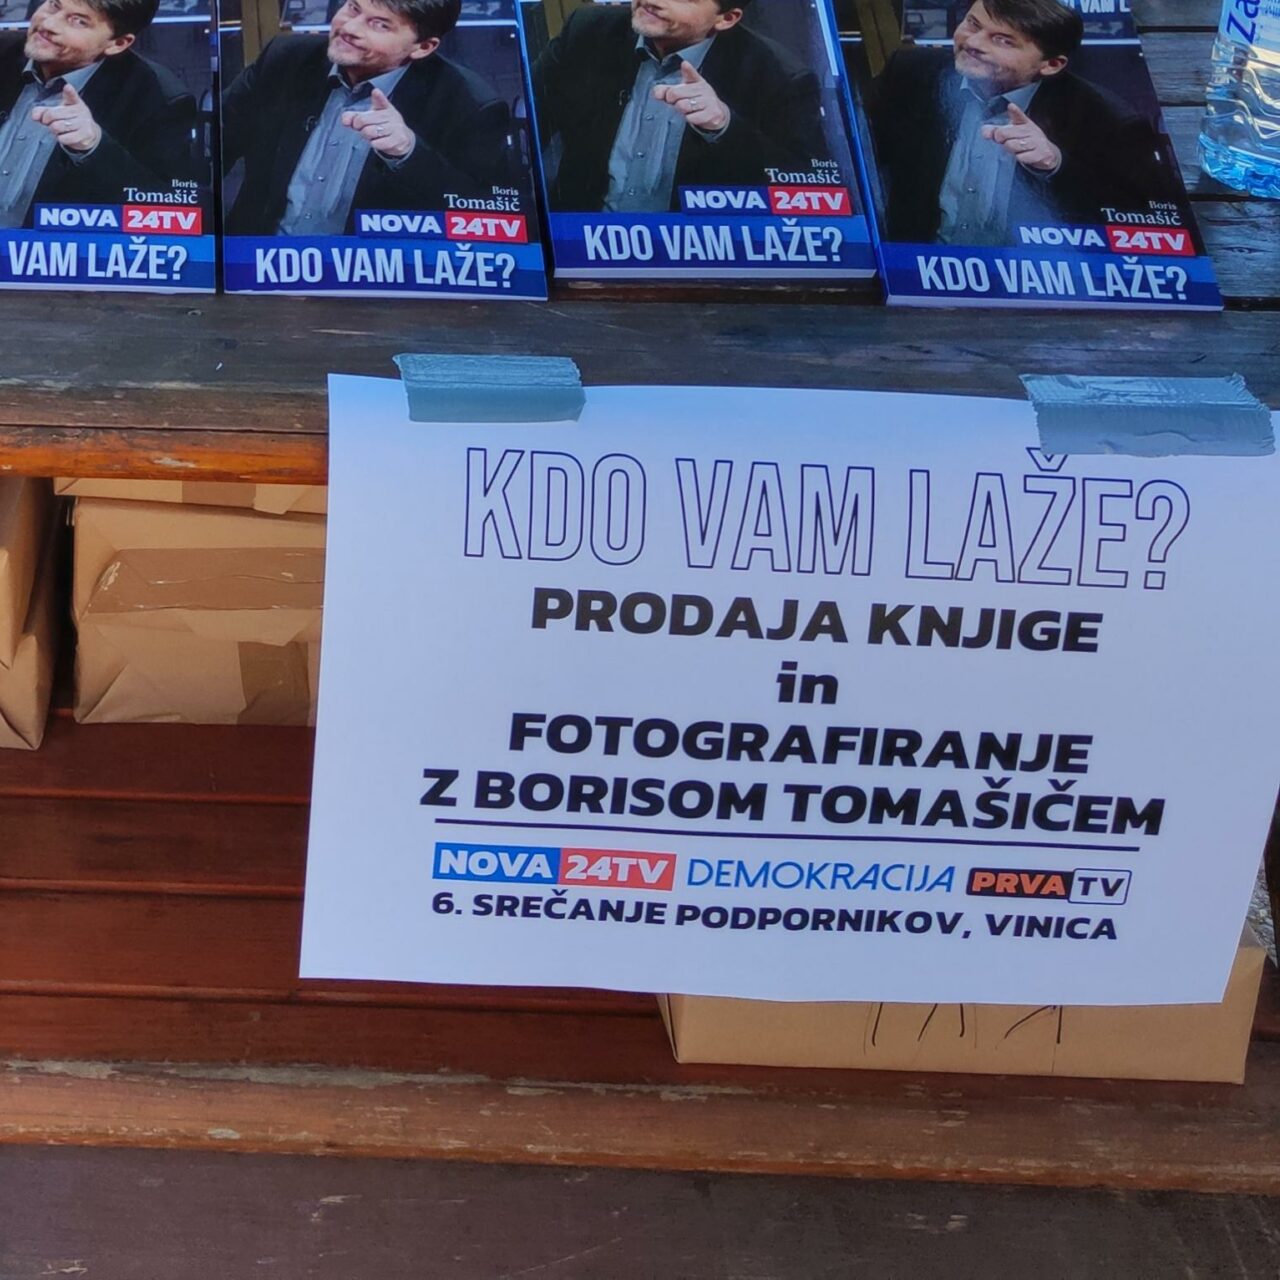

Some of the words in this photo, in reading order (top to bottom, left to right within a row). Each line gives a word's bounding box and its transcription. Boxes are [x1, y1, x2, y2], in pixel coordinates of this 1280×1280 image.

[811, 158, 838, 168] Boris
[171, 178, 198, 189] Boris
[764, 167, 842, 185] Tomašič
[123, 187, 199, 205] Tomašič
[443, 193, 520, 212] Tomašič
[491, 185, 519, 196] Boris
[684, 190, 767, 209] NOVA
[774, 191, 844, 211] 24TV
[1100, 207, 1182, 227] Tomašič
[1148, 199, 1177, 211] Boris
[39, 208, 119, 228] NOVA
[127, 210, 197, 230] 24TV
[360, 213, 442, 234] NOVA
[451, 216, 521, 238] 24TV
[583, 224, 654, 261] KDO
[659, 225, 737, 261] VAM
[741, 217, 843, 263] LAŽE?
[1019, 226, 1106, 248] NOVA
[1112, 230, 1185, 251] 24TV
[8, 241, 78, 277] VAM
[87, 236, 188, 281] LAŽE?
[255, 247, 323, 284] KDO
[330, 247, 405, 284] VAM
[413, 242, 516, 288] LAŽE?
[916, 255, 991, 293] KDO
[994, 257, 1076, 296] VAM
[1080, 255, 1188, 301] LAŽE?
[463, 447, 647, 567] KDO
[674, 457, 876, 576] VAM
[904, 447, 1191, 591] LAŽE?
[530, 586, 849, 643] PRODAJA
[867, 602, 1104, 653] KNJIGE
[775, 660, 840, 705] in
[508, 712, 1094, 774] FOTOGRAFIRANJE
[419, 767, 460, 808] Z
[473, 769, 769, 822] BORISOM
[782, 776, 1166, 837] TOMAŠIČEM
[438, 848, 553, 880] NOVA
[564, 854, 670, 885] 24TV
[686, 858, 956, 893] DEMOKRACIJA
[971, 870, 1068, 897] PRVA
[1077, 875, 1126, 898] TV
[431, 891, 463, 916] 6.
[471, 887, 669, 925] SREČANJE
[674, 904, 972, 940] PODPORNIKOV,
[984, 913, 1118, 941] VINICA
